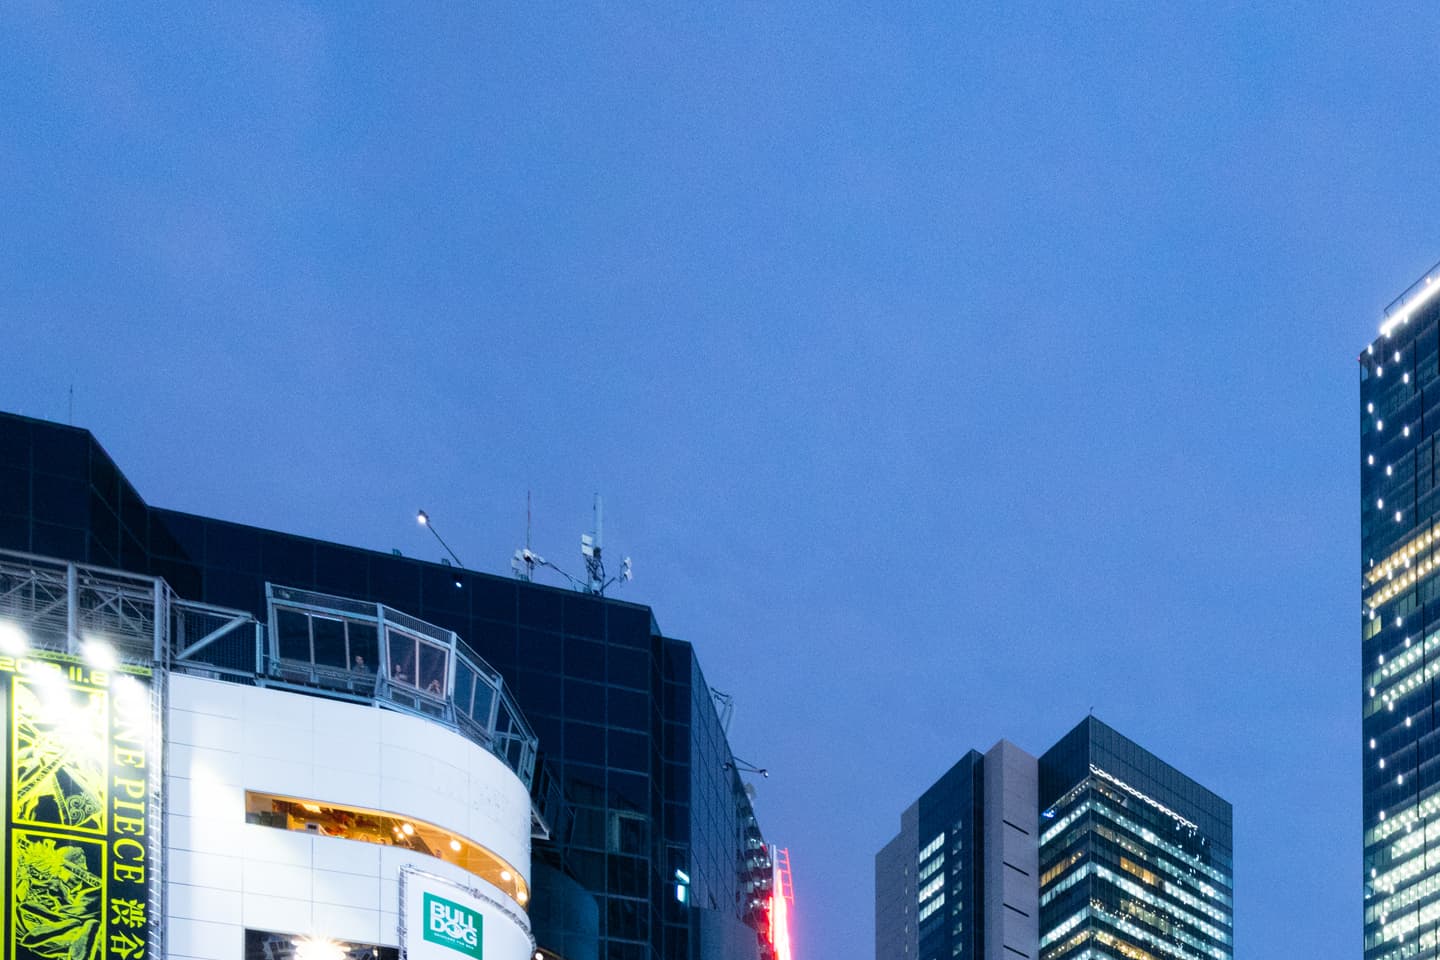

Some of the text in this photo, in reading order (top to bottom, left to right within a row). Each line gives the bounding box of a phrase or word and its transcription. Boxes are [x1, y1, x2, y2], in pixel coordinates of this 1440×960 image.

[112, 776, 146, 885] PIECE
[430, 900, 477, 933] BULL
[430, 918, 477, 948] DOG
